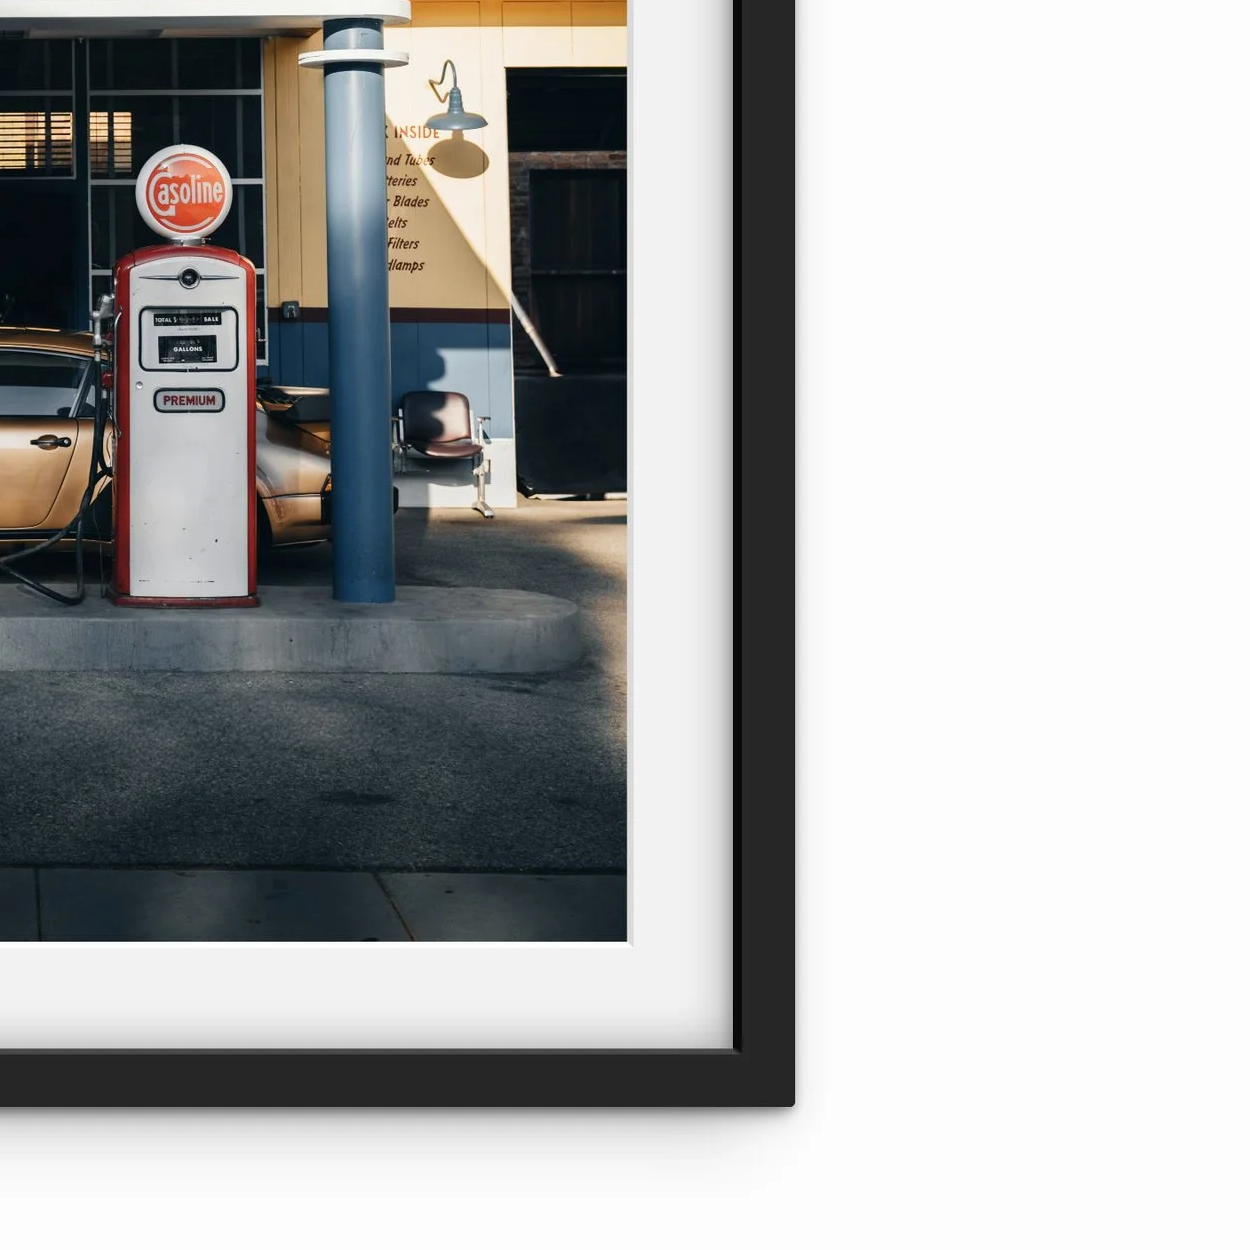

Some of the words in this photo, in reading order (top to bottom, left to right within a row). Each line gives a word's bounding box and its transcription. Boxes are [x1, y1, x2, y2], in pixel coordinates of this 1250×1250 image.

[394, 125, 440, 139] INSIDE
[386, 153, 402, 166] nd
[404, 153, 436, 166] Tubes
[148, 171, 224, 217] Gasoline
[393, 195, 430, 208] Blades
[387, 216, 409, 229] elts
[387, 236, 420, 250] Filters
[163, 395, 216, 406] PREMIUM
